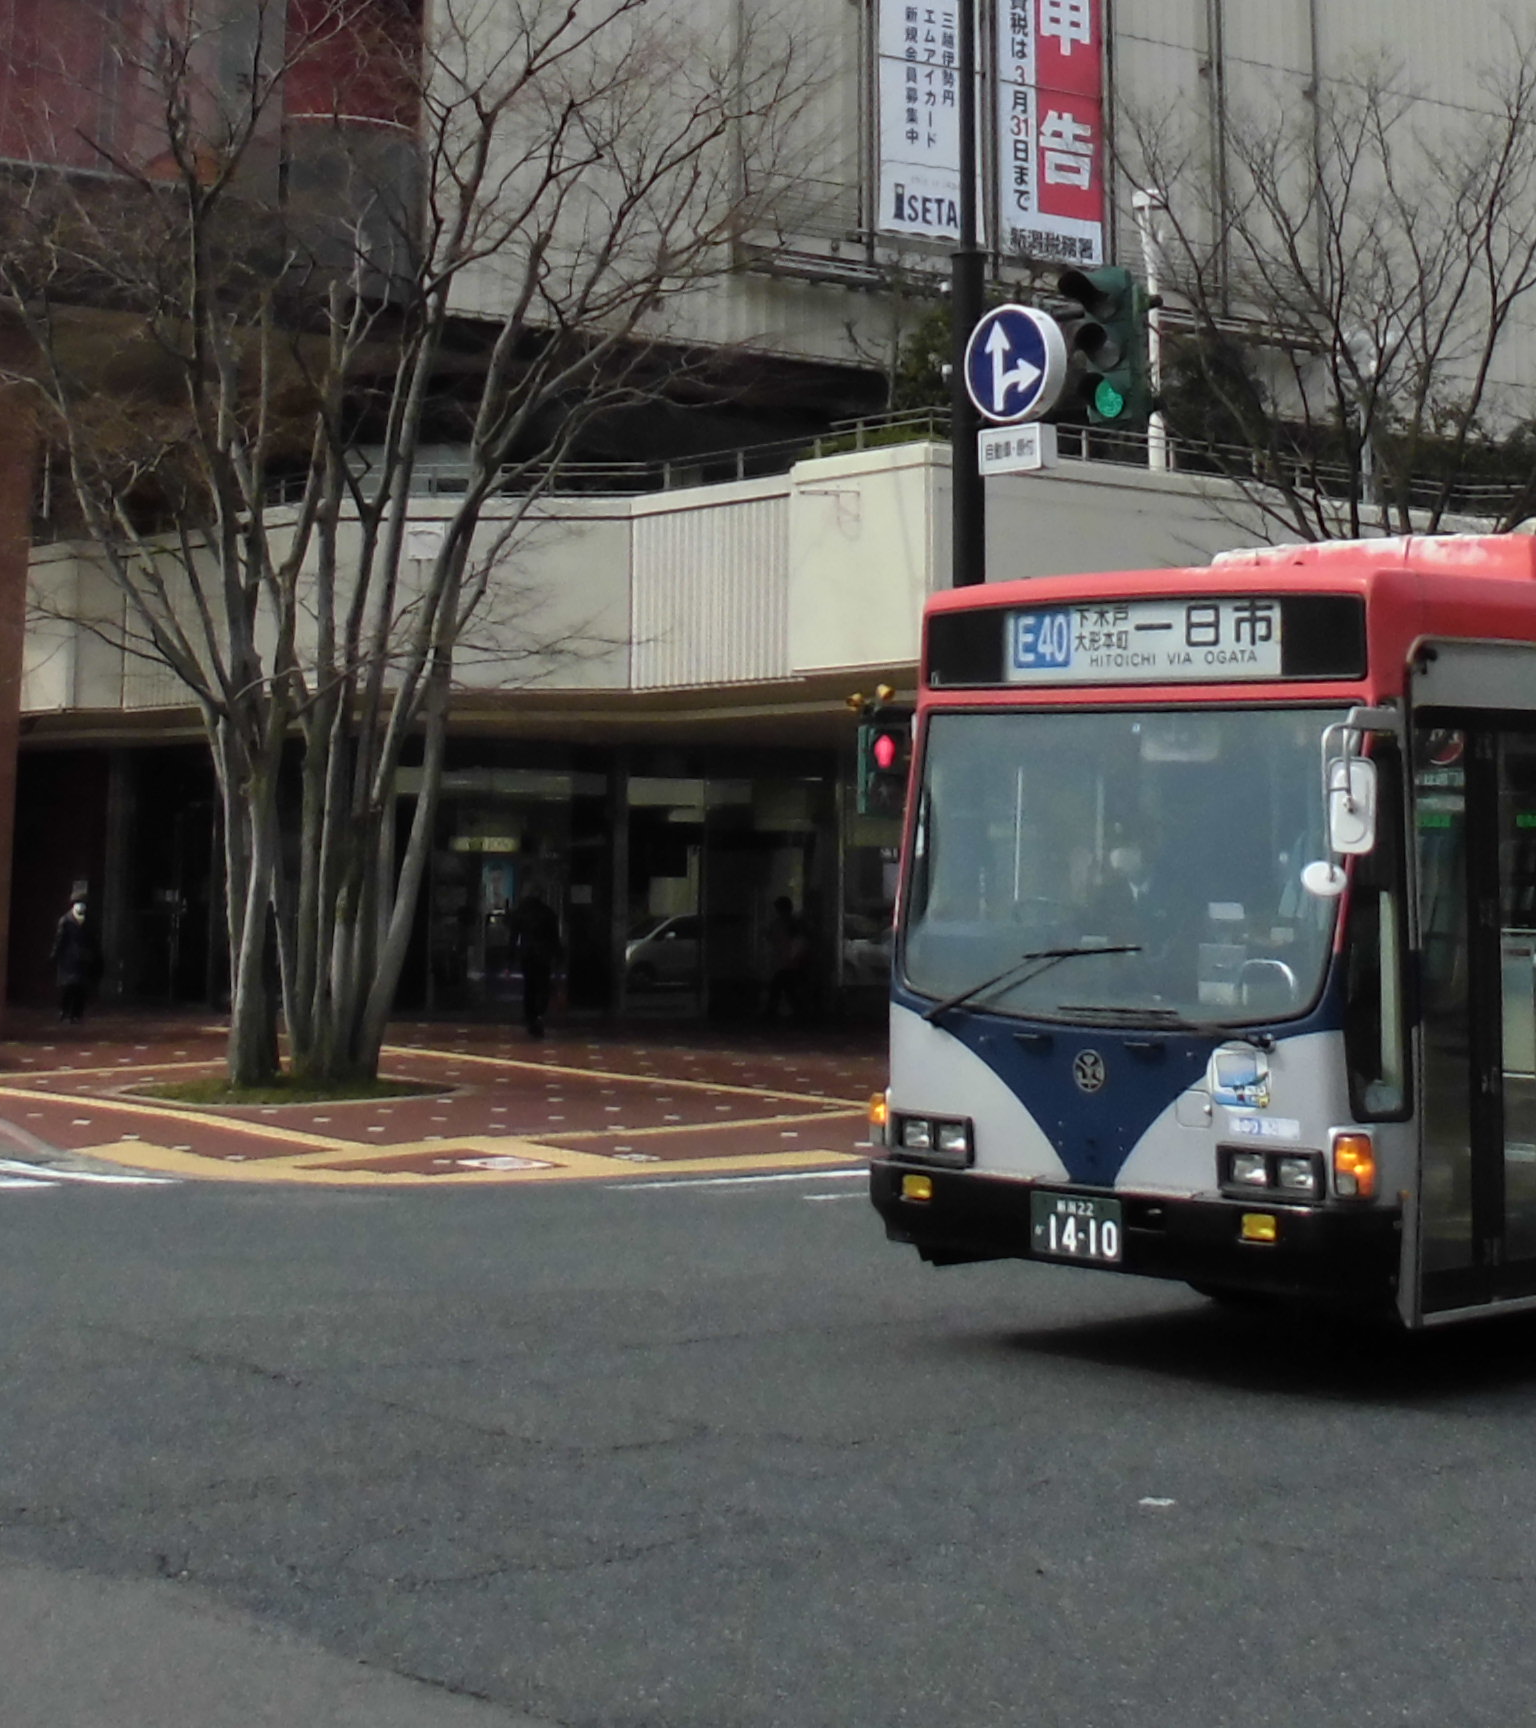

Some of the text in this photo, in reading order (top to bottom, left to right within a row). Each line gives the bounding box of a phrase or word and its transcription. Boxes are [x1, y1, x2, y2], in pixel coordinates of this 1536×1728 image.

[893, 182, 959, 230] ISETA
[1018, 612, 1069, 662] E40
[1075, 605, 1129, 629] 下木戸
[1134, 600, 1274, 648] 一日市
[1075, 630, 1129, 652] 大形本町
[1090, 649, 1258, 668] HITOICHI VIA OGATA
[1049, 1213, 1117, 1257] 14-10
